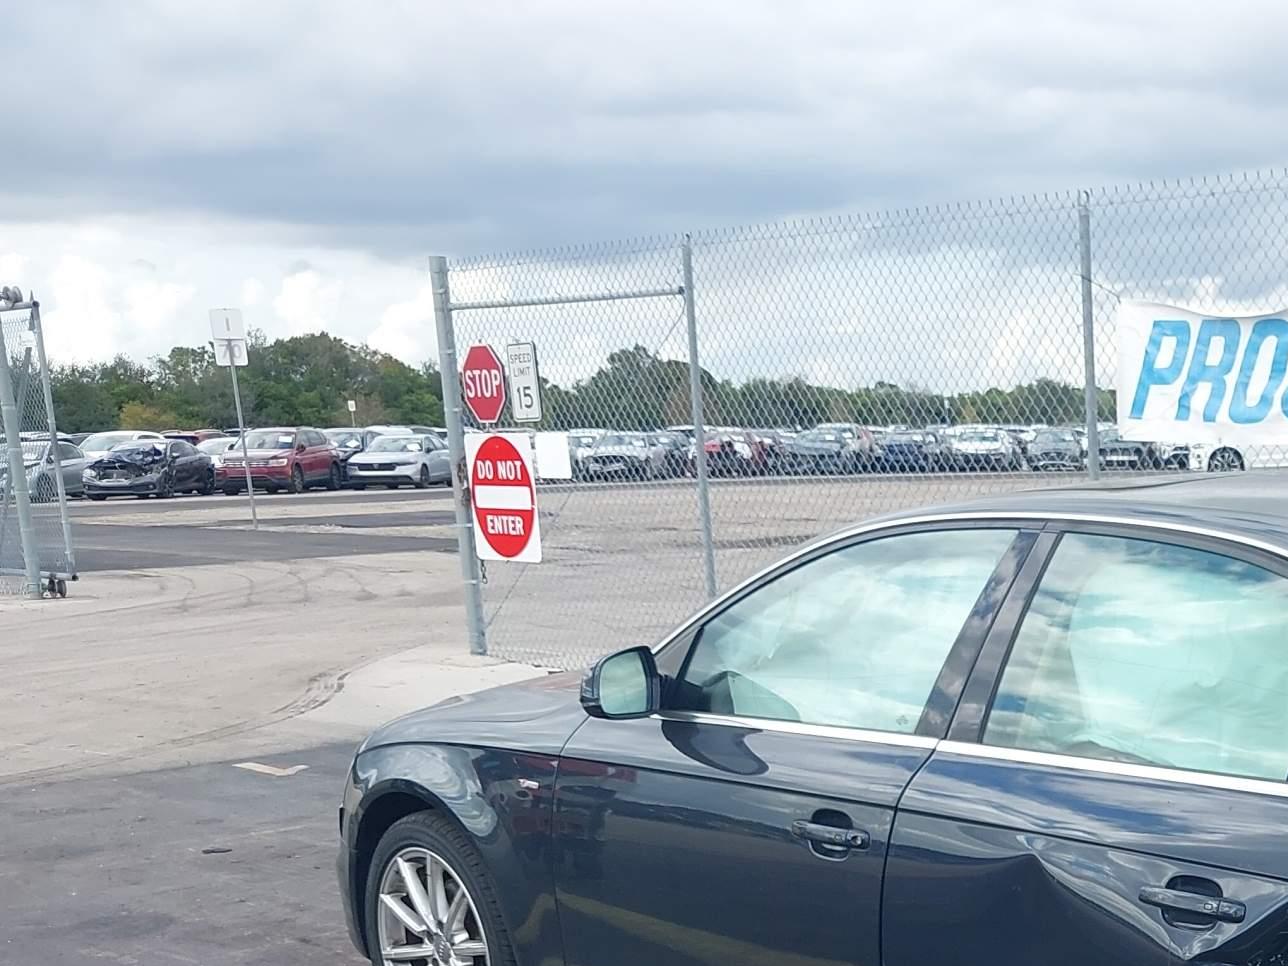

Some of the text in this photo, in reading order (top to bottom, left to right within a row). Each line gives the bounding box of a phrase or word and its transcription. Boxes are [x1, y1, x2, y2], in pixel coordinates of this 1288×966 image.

[510, 353, 532, 364] SPEED
[513, 366, 531, 378] LIMIT
[465, 369, 500, 398] STOP
[516, 386, 535, 410] 15
[476, 460, 522, 481] DO NOT
[486, 515, 525, 536] ENTER
